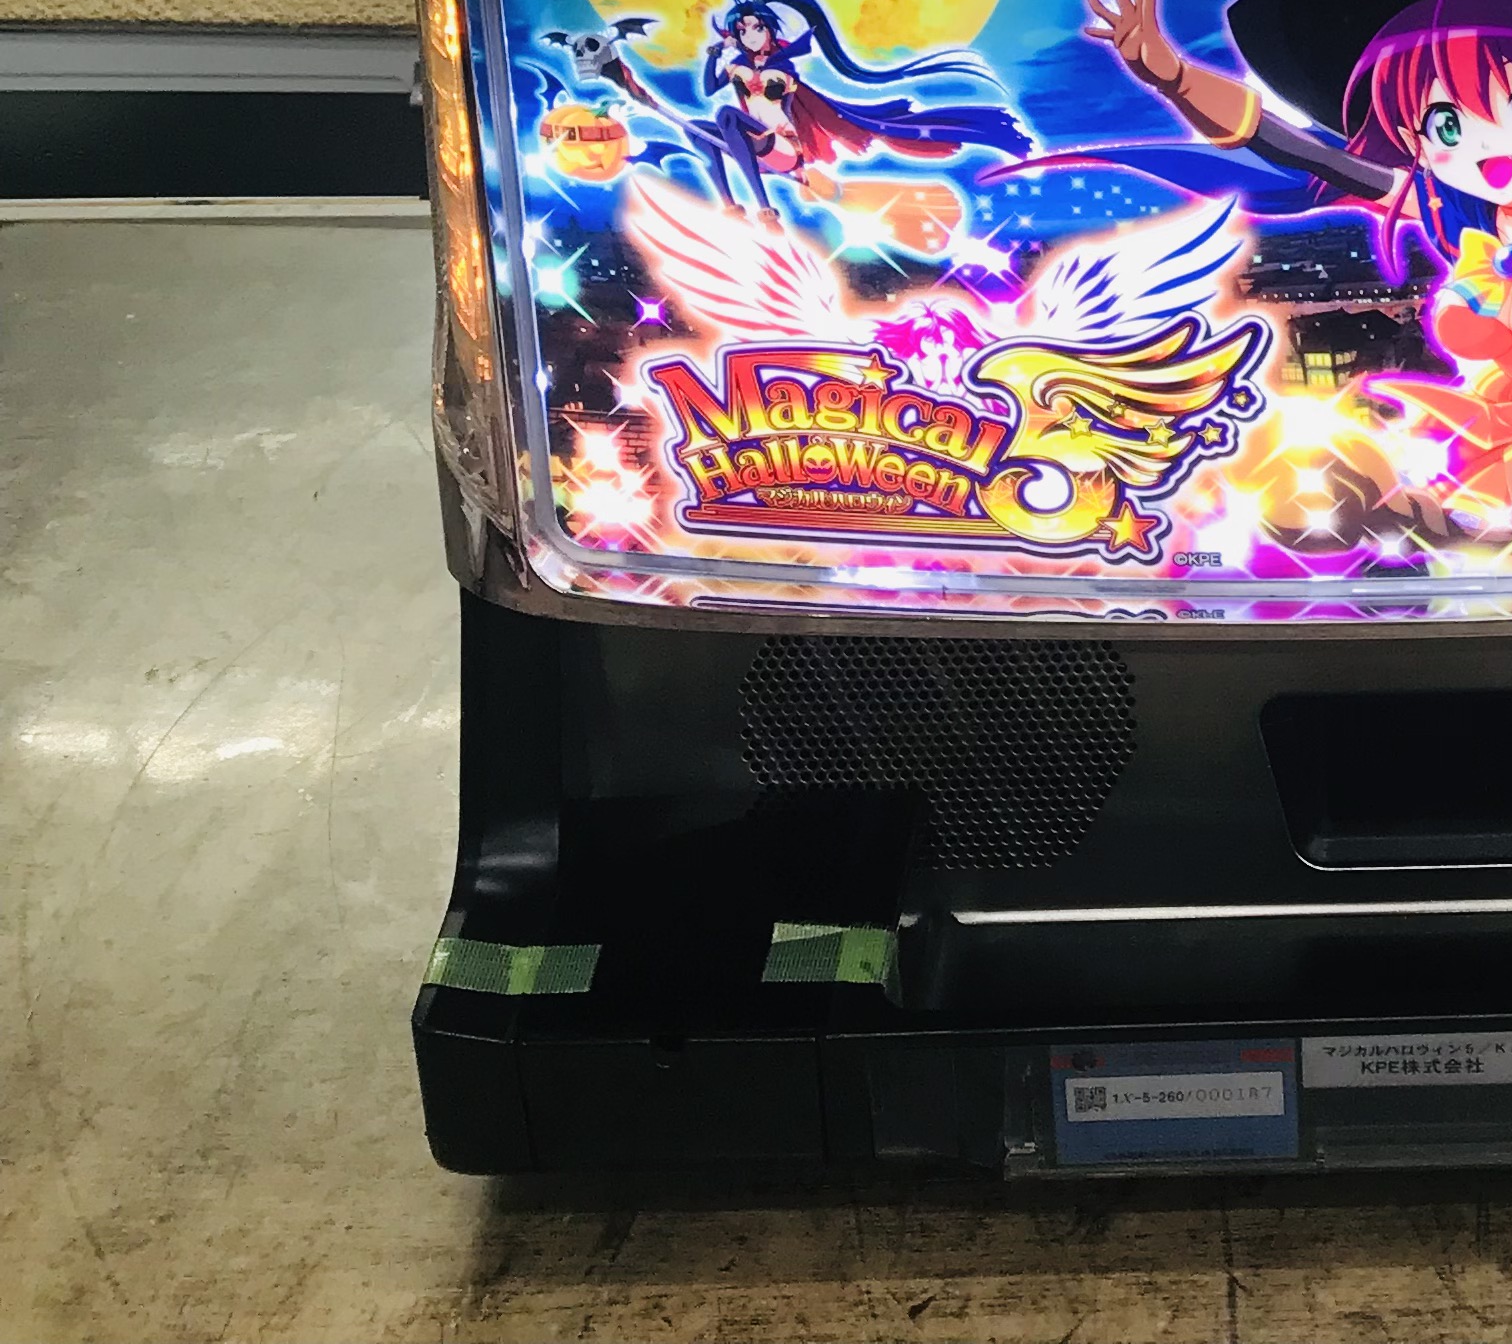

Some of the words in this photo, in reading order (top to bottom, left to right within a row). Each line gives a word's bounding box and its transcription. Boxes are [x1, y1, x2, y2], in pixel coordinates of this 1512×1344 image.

[652, 352, 1010, 475] Magical
[756, 486, 914, 511] マジカルハロウィン
[1361, 1057, 1485, 1076] KPE株式会社
